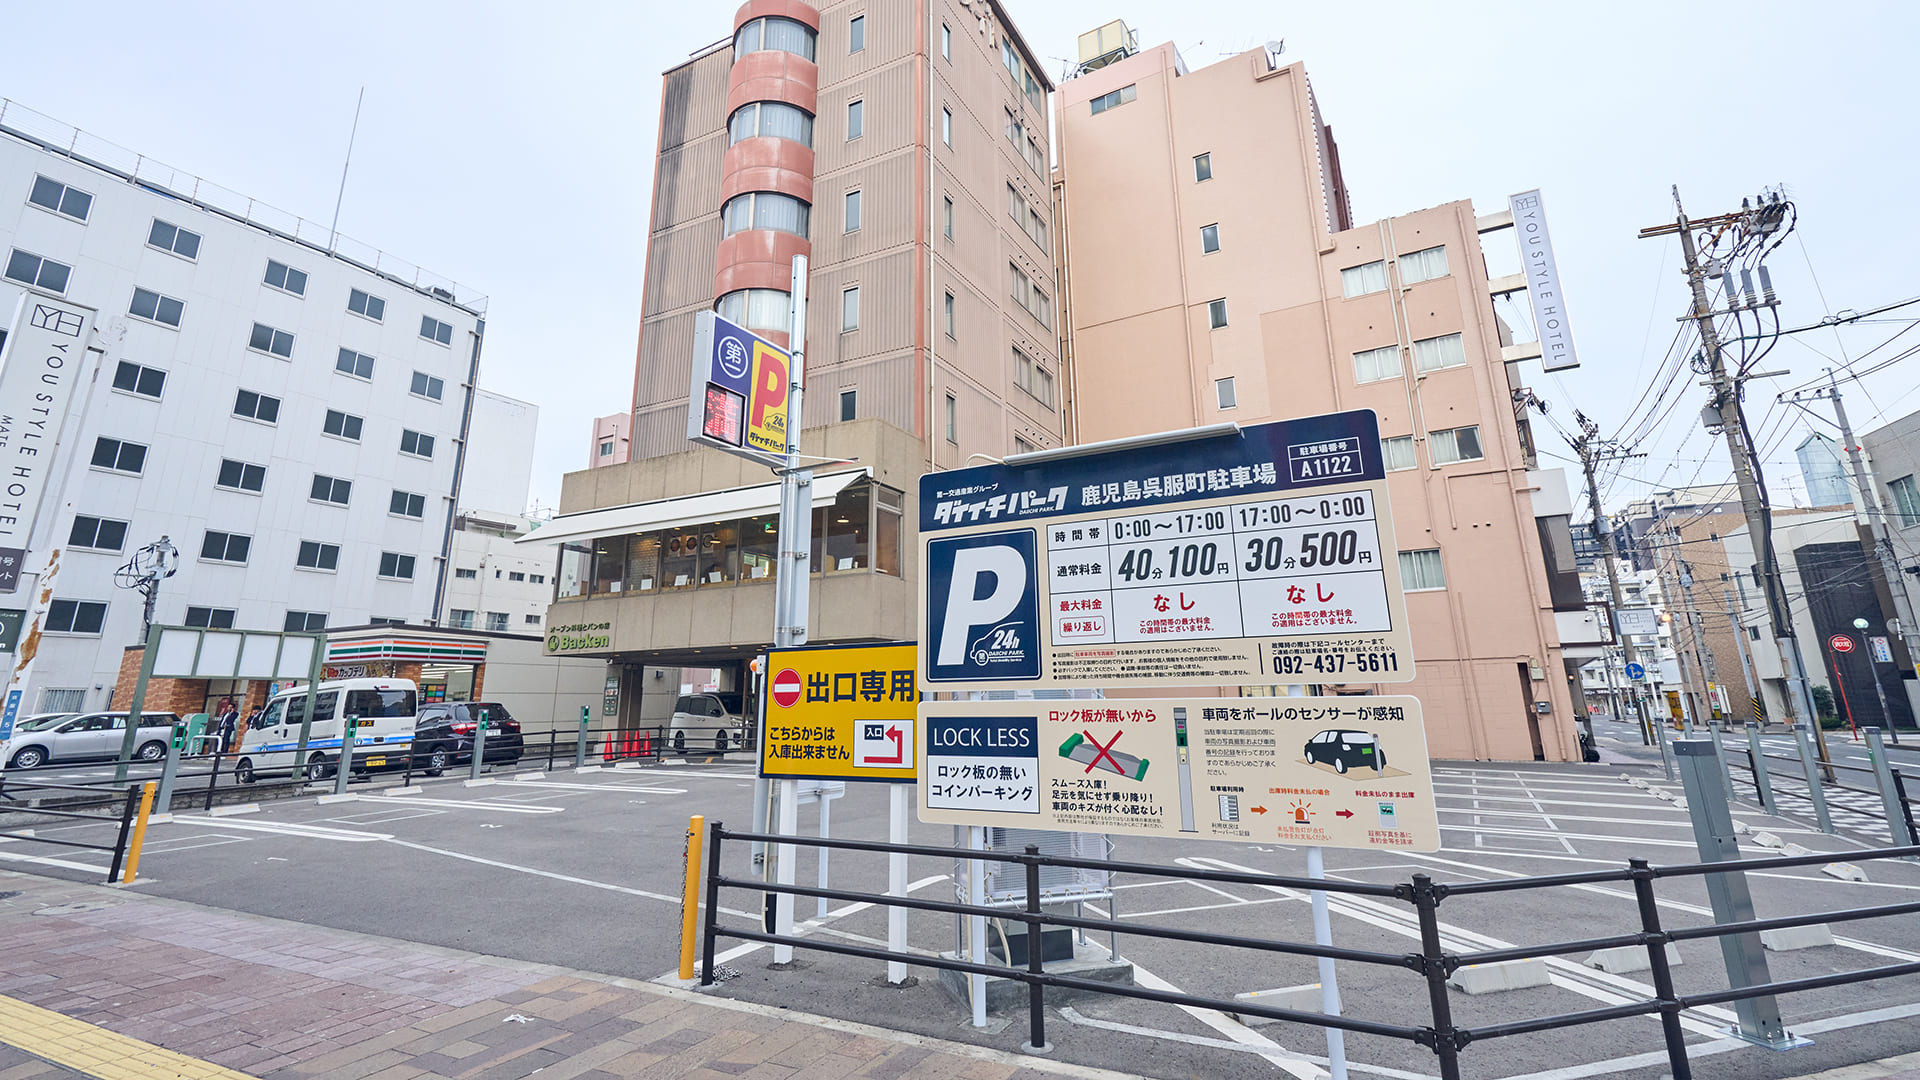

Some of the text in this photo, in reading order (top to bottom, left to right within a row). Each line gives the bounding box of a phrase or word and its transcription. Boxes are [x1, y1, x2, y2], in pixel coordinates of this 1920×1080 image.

[1524, 212, 1566, 360] YOU STYLE HOTEL
[725, 341, 742, 372] 第一
[41, 344, 68, 385] YOU
[752, 352, 787, 428] P
[20, 393, 52, 456] STYLE
[1300, 442, 1347, 456] 駐車場番号
[1302, 456, 1352, 477] A1122
[1082, 462, 1276, 506] 鹿児島呉服町駐車場
[1055, 528, 1100, 542] 時間帯
[1057, 563, 1102, 577] 通常料金
[1060, 583, 1334, 612] 最大料金 なし なし
[937, 545, 1026, 666] P
[1140, 617, 1210, 627] この時間帯の最大料金
[1272, 609, 1352, 620] この時間帯の最大料金
[1063, 620, 1101, 632] 繰り返し
[1140, 625, 1215, 634] の適用はございません。
[1272, 618, 1358, 628] の適用はございません。
[560, 634, 609, 650] Backen
[991, 629, 1020, 649] 24h
[1273, 652, 1398, 674] 092-437-5611
[807, 670, 914, 703] 出口専用
[1049, 709, 1156, 723] ロック板が無いから
[1202, 706, 1404, 721] 車両をポールのセンサーが感知
[770, 727, 835, 741] こちらからは
[866, 728, 882, 737] 入口
[934, 728, 1030, 747] LOCK LESS
[769, 745, 850, 760] 入庫出来ません
[938, 765, 1026, 781] ロック板の無い
[1052, 779, 1107, 790] スムーズ入庫！
[932, 784, 1033, 801] コインパーキング
[1052, 790, 1153, 803] 足元を気にせず乗り降り！
[1052, 802, 1163, 816] 車両のキズが付く心配なし！
